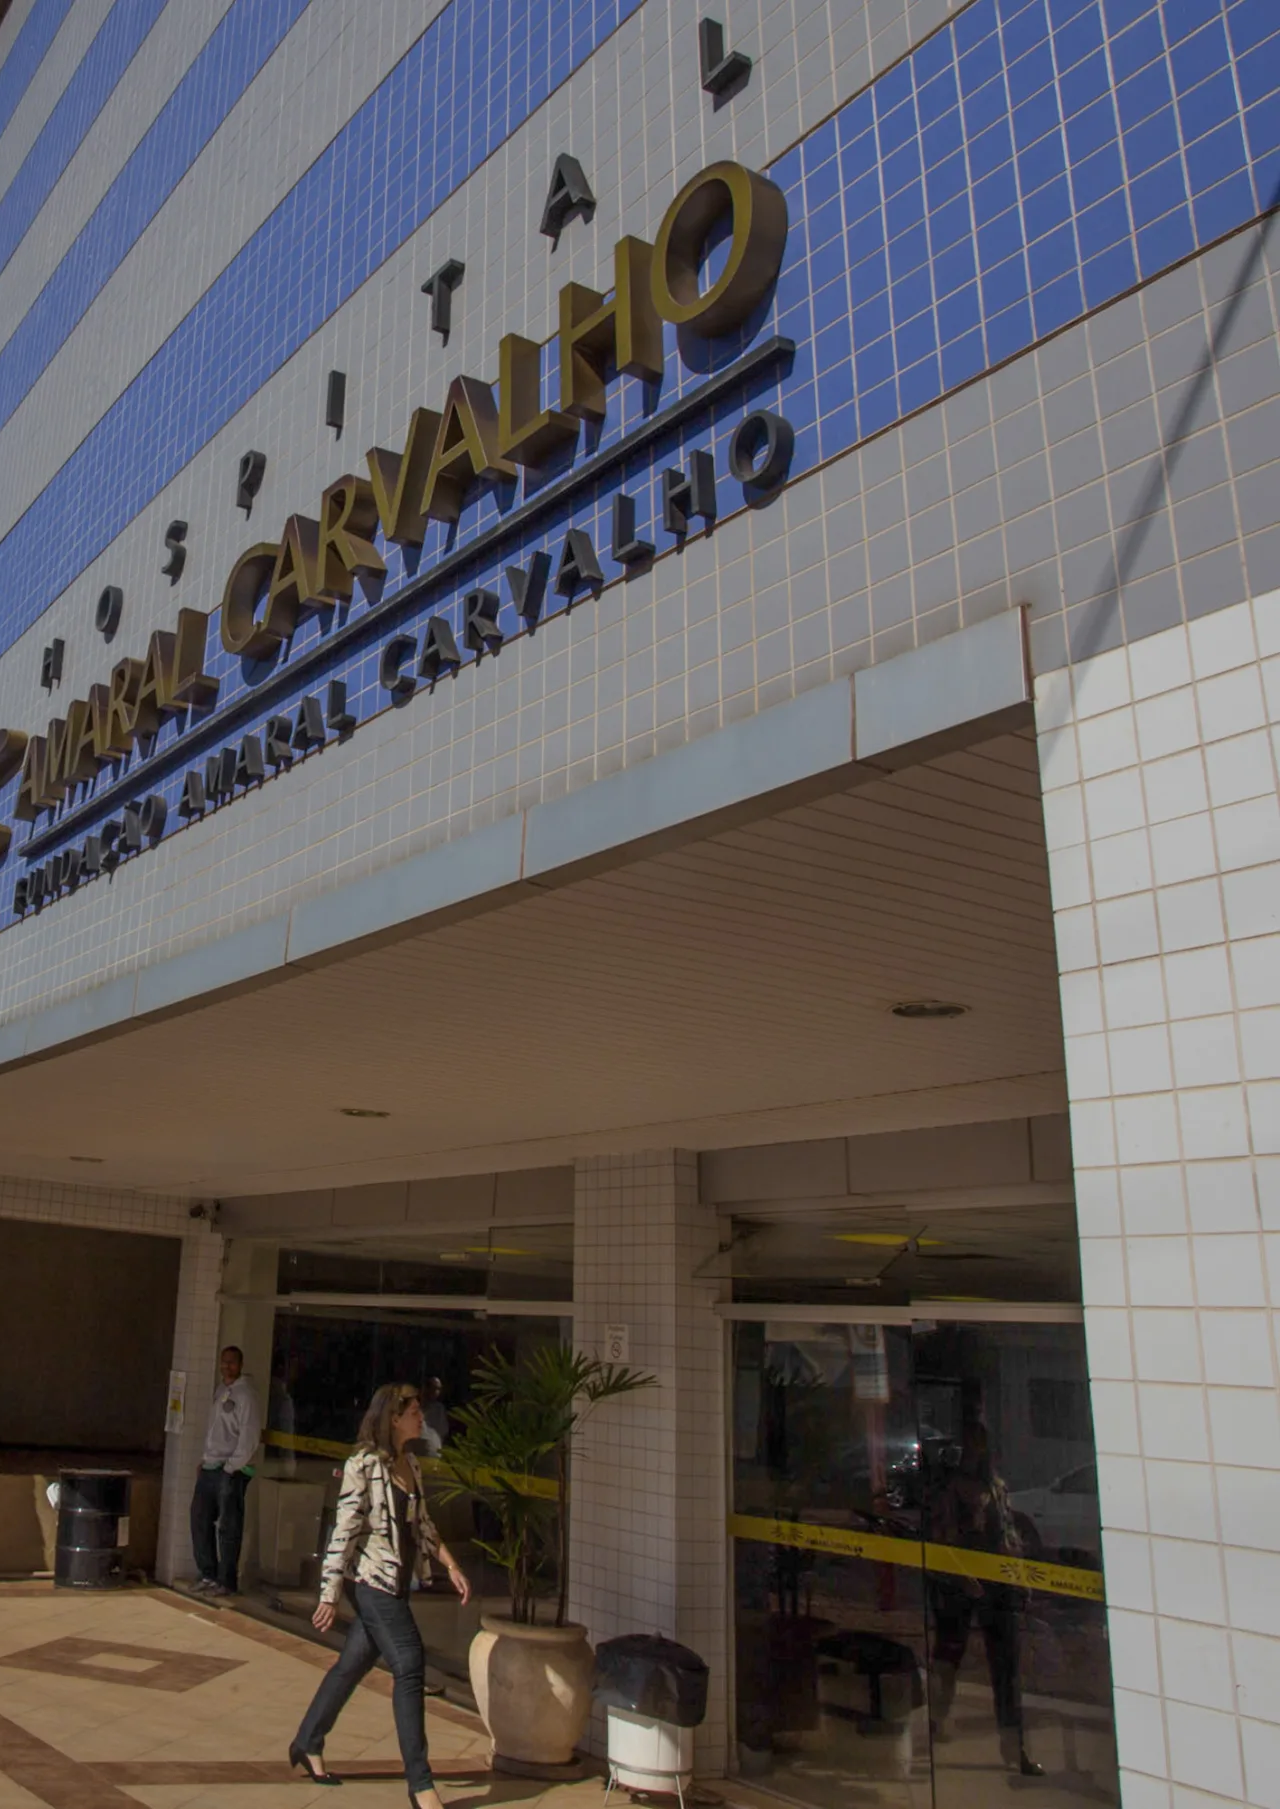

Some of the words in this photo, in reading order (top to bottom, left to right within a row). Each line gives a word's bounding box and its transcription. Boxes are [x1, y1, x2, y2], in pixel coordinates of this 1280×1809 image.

[14, 608, 220, 822] AMARAL
[221, 160, 788, 657] CARVALHO
[178, 680, 356, 818] AMARAL
[380, 409, 795, 692] CARVALHO
